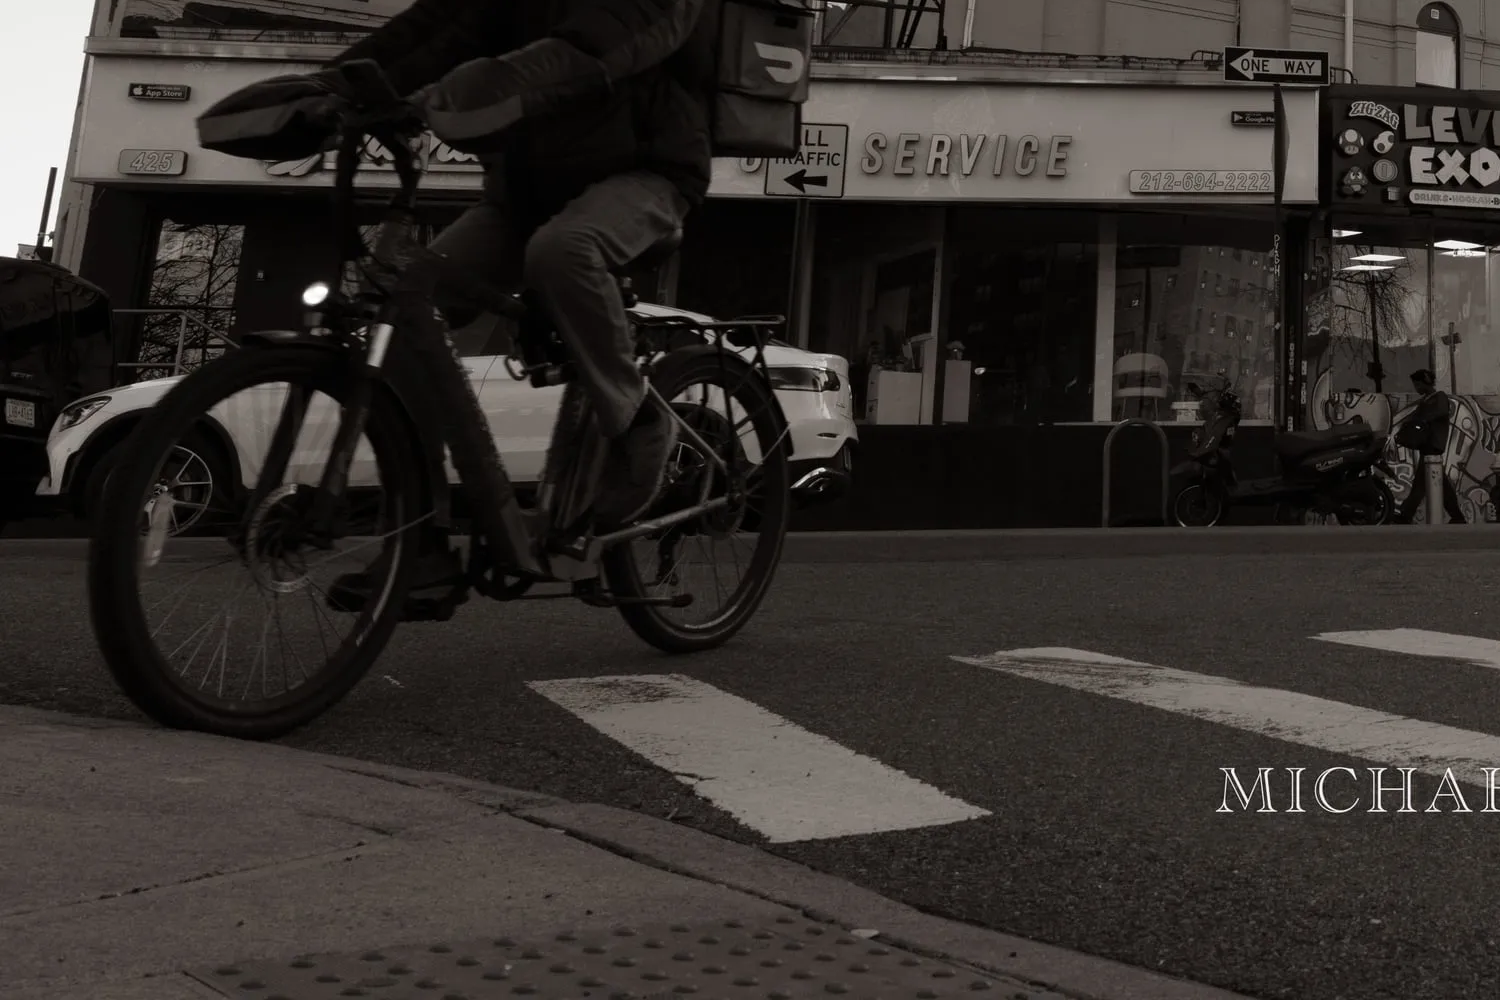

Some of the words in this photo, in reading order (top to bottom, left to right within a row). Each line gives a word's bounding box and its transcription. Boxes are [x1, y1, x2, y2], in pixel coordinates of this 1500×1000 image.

[1240, 58, 1270, 73] ONE
[1284, 60, 1316, 75] WAY
[1245, 115, 1266, 123] Google
[800, 129, 829, 147] LL
[130, 152, 174, 172] 425
[861, 132, 1073, 176] SERVICE
[1139, 172, 1271, 191] 212-694-2222
[1414, 192, 1449, 202] DRINKS
